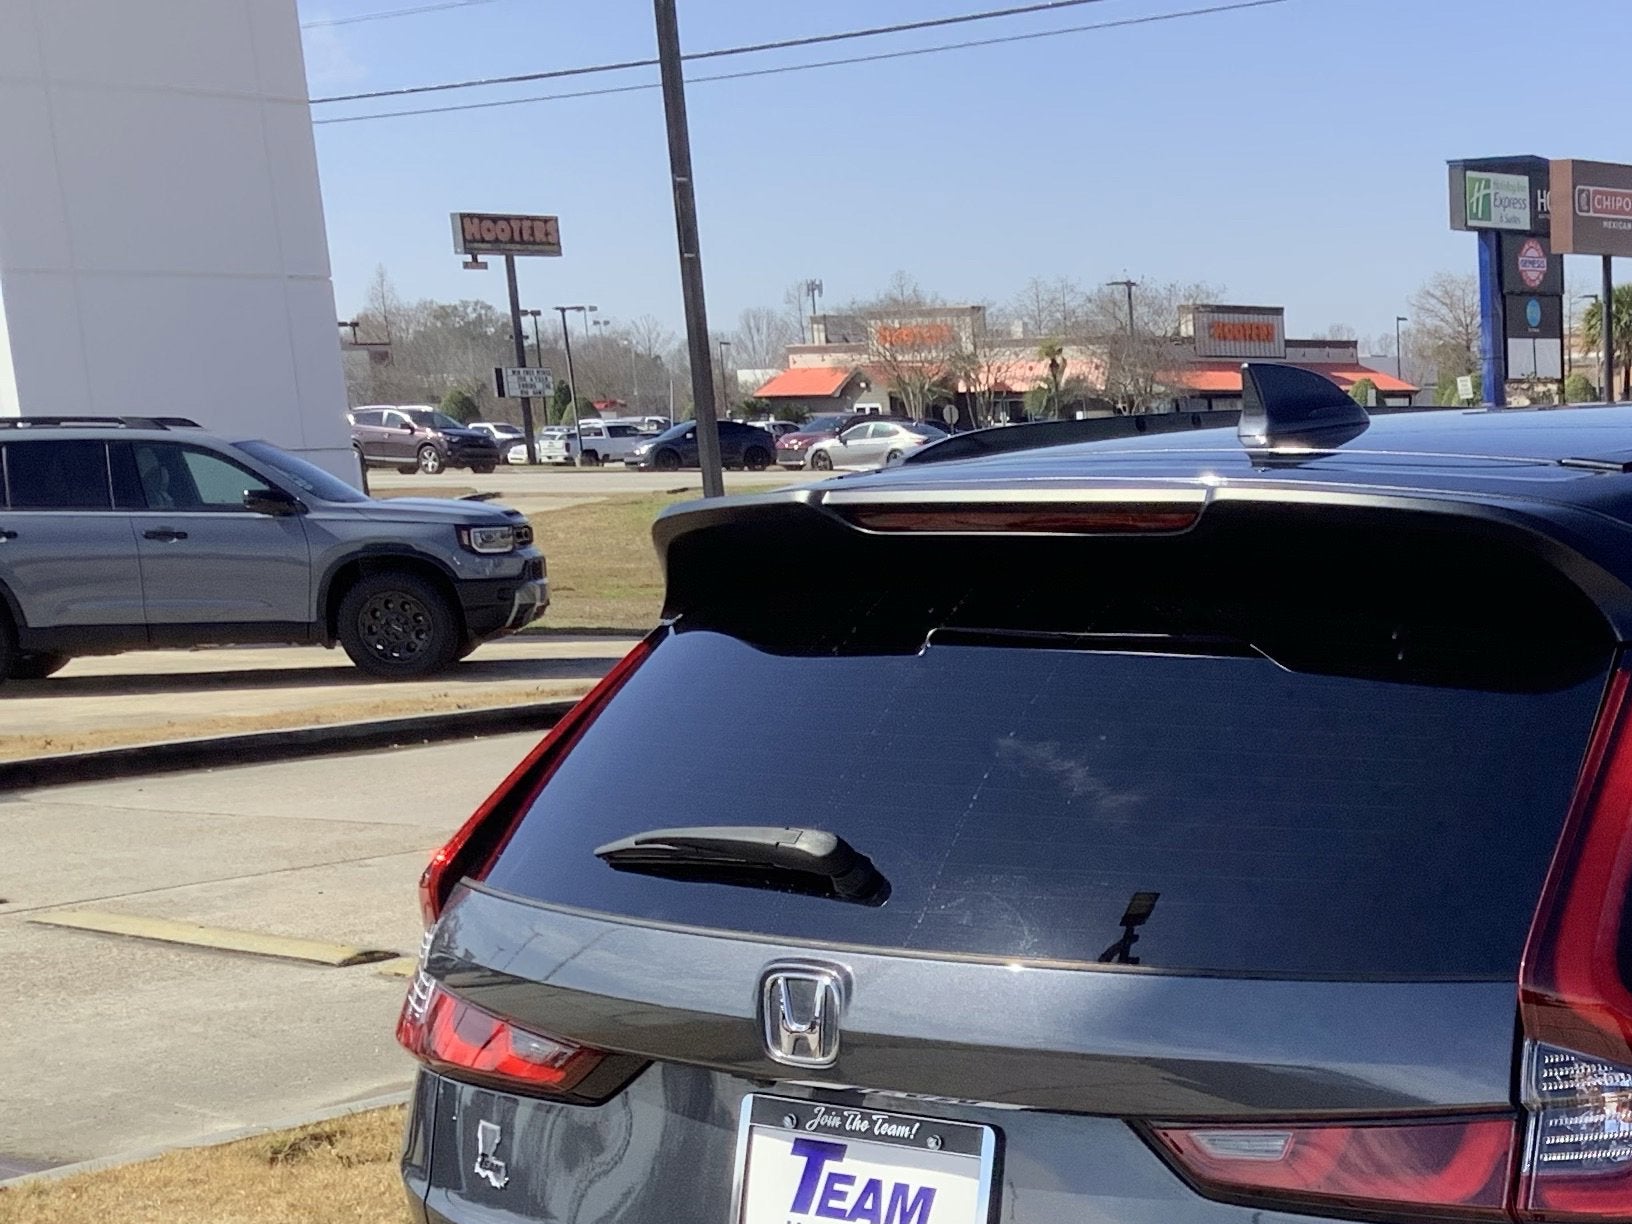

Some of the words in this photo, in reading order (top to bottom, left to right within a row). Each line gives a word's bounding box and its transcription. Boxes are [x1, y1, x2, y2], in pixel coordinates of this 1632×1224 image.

[1494, 192, 1527, 212] Express
[463, 216, 558, 243] HOOTERS
[805, 1107, 842, 1131] Join
[843, 1110, 871, 1132] The
[872, 1113, 921, 1140] Team!
